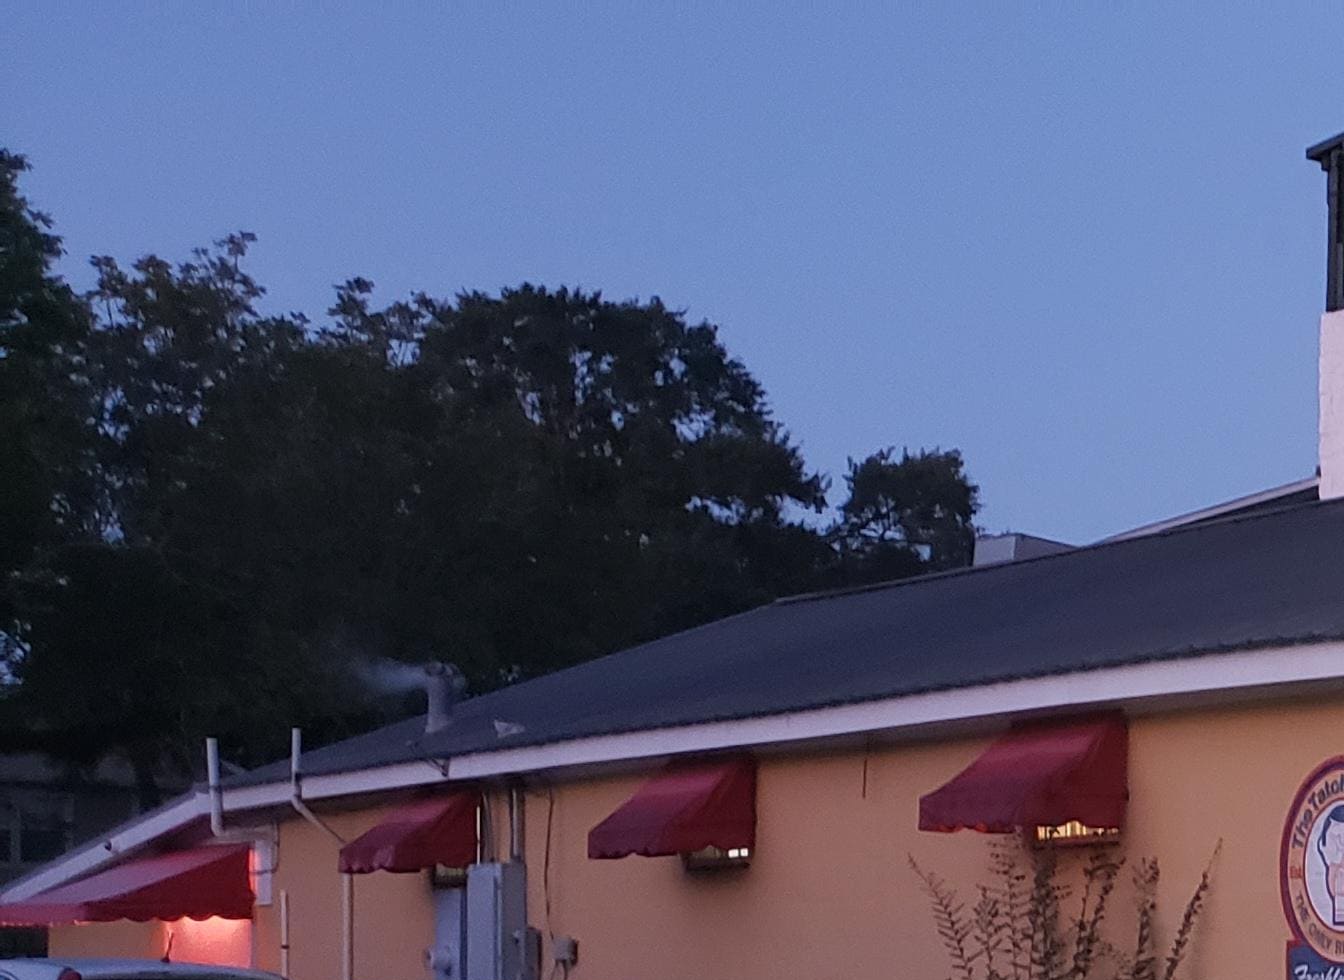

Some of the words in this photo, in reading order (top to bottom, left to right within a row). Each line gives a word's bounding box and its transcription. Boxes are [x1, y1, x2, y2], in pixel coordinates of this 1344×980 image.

[1292, 809, 1313, 849] The
[1296, 892, 1311, 923] THE
[1308, 922, 1334, 950] ONLY
